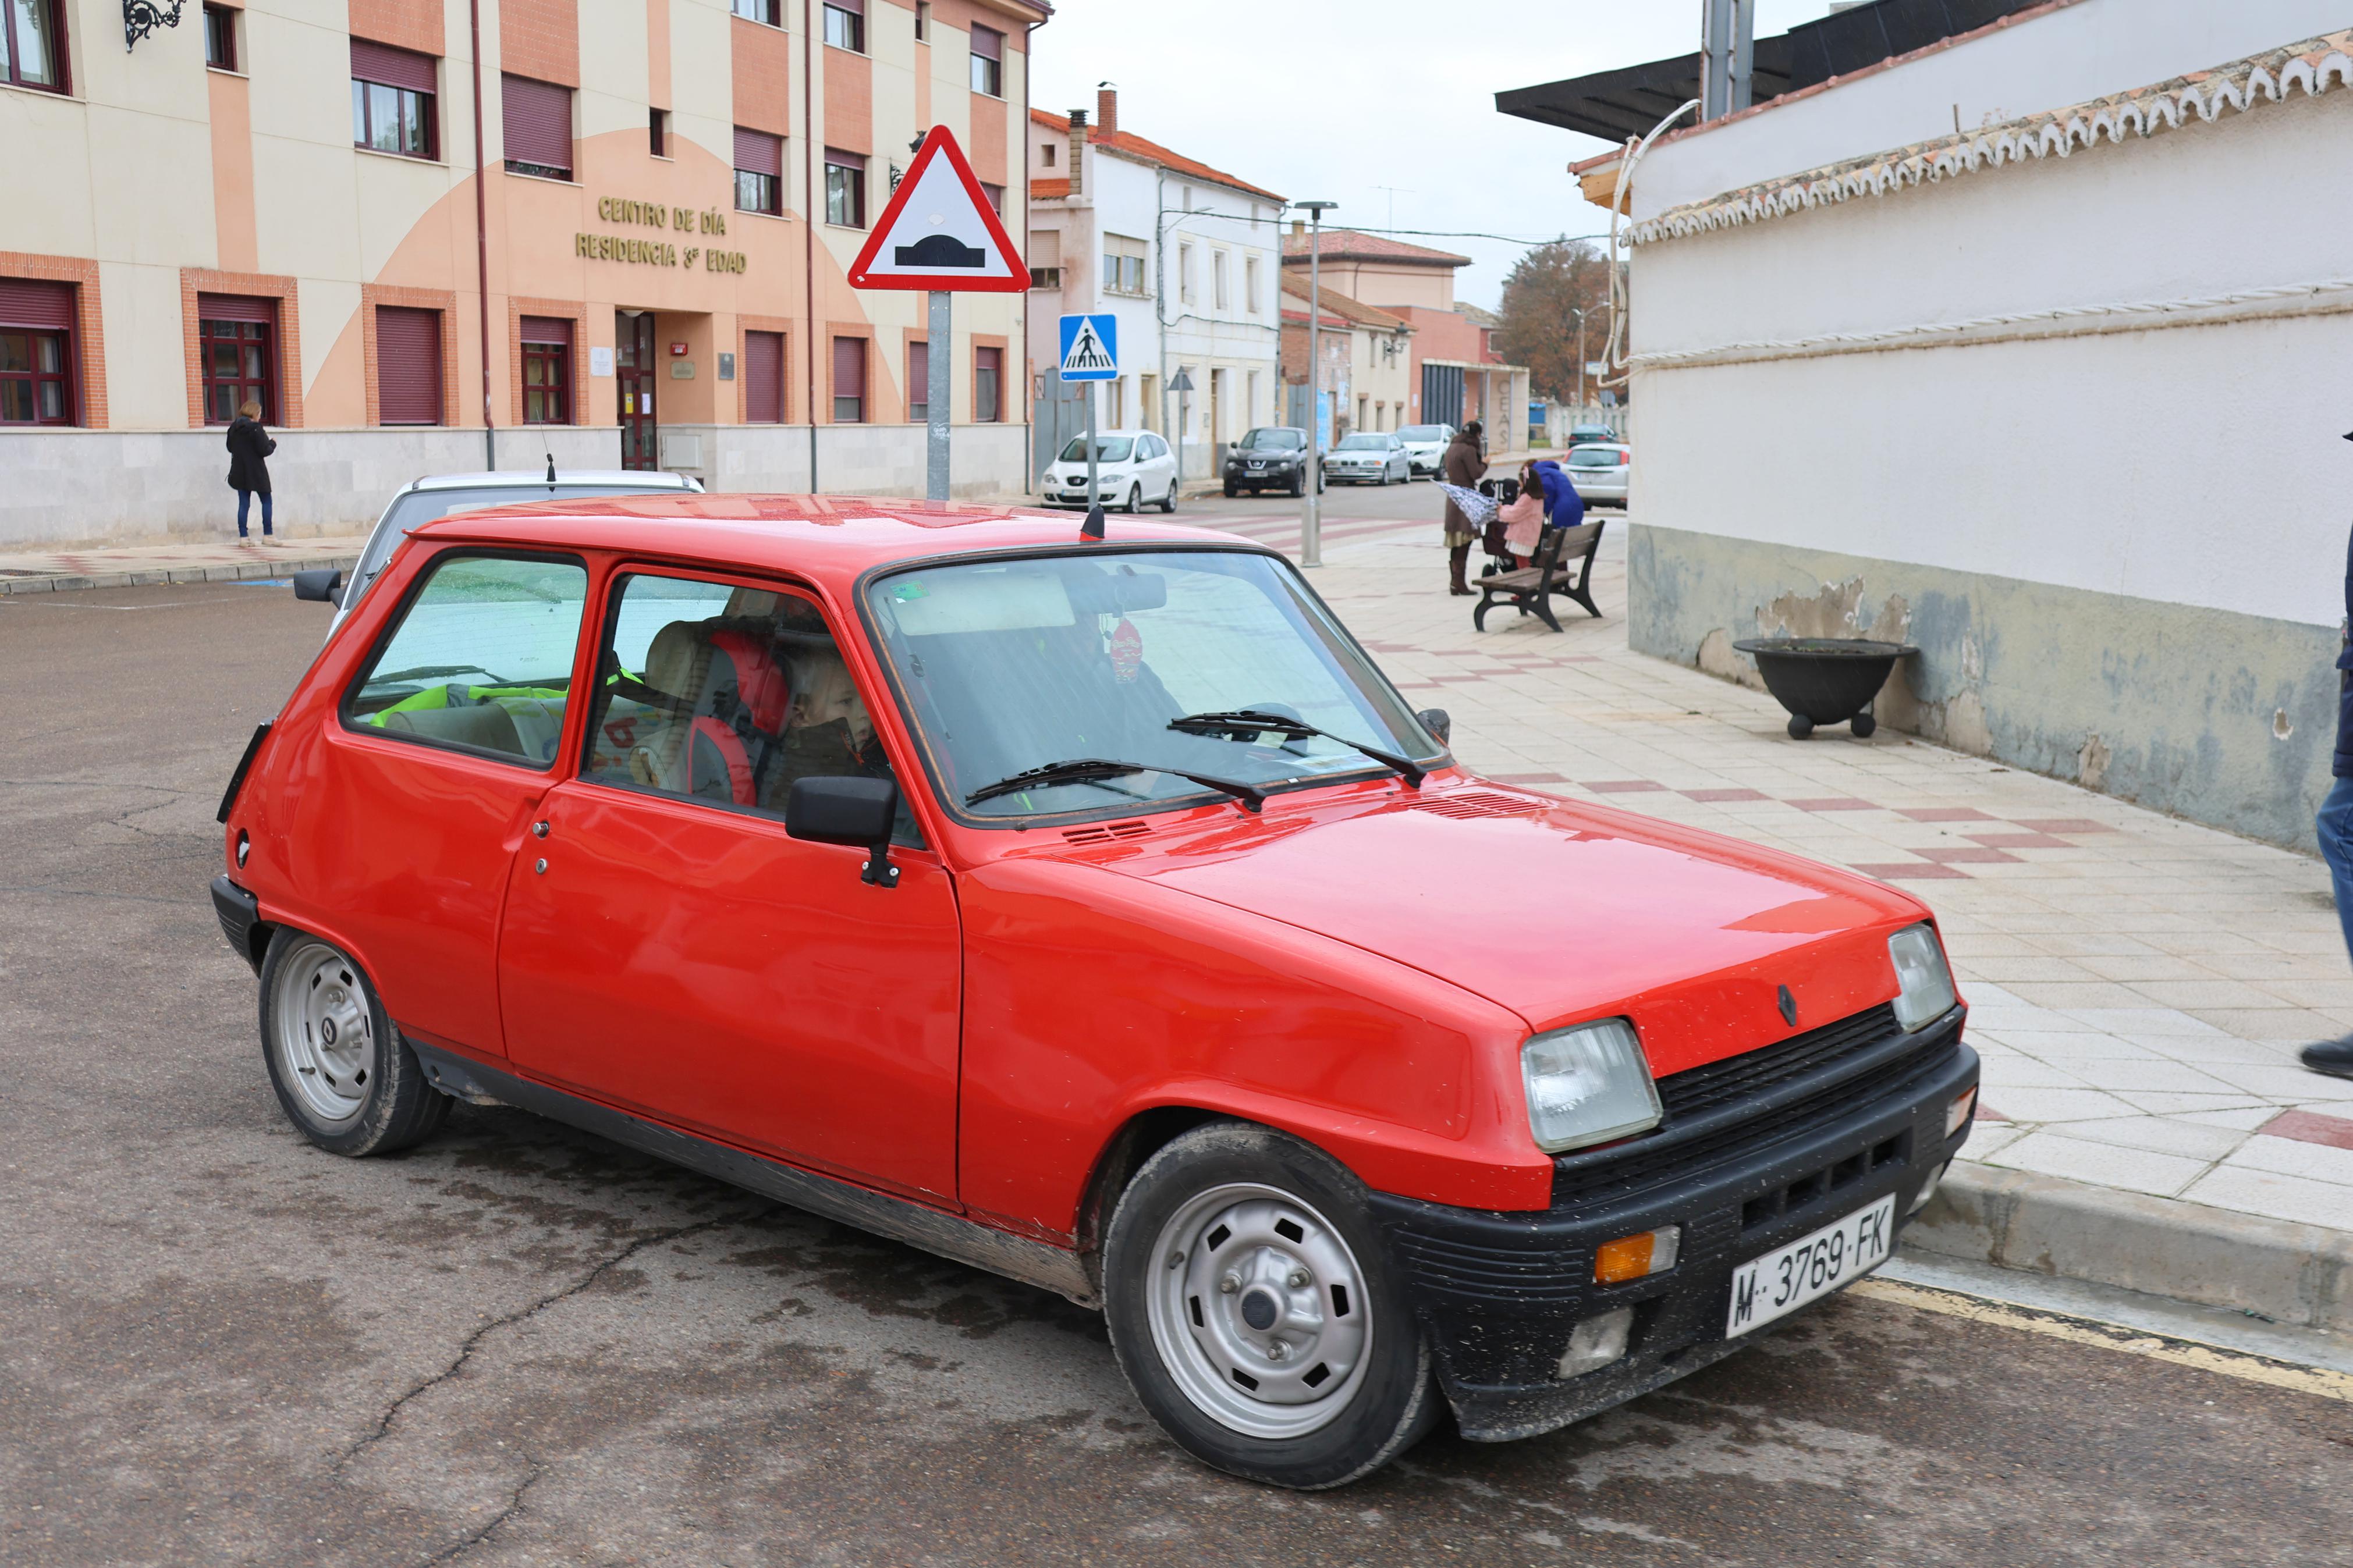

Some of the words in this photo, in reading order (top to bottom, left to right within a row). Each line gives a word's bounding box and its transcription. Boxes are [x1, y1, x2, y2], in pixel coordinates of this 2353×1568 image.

[598, 195, 668, 228] CENTRO
[673, 207, 695, 232] DE
[700, 206, 726, 236] DÍA
[575, 233, 677, 266] RESIDENCIA
[707, 248, 747, 274] EDAD
